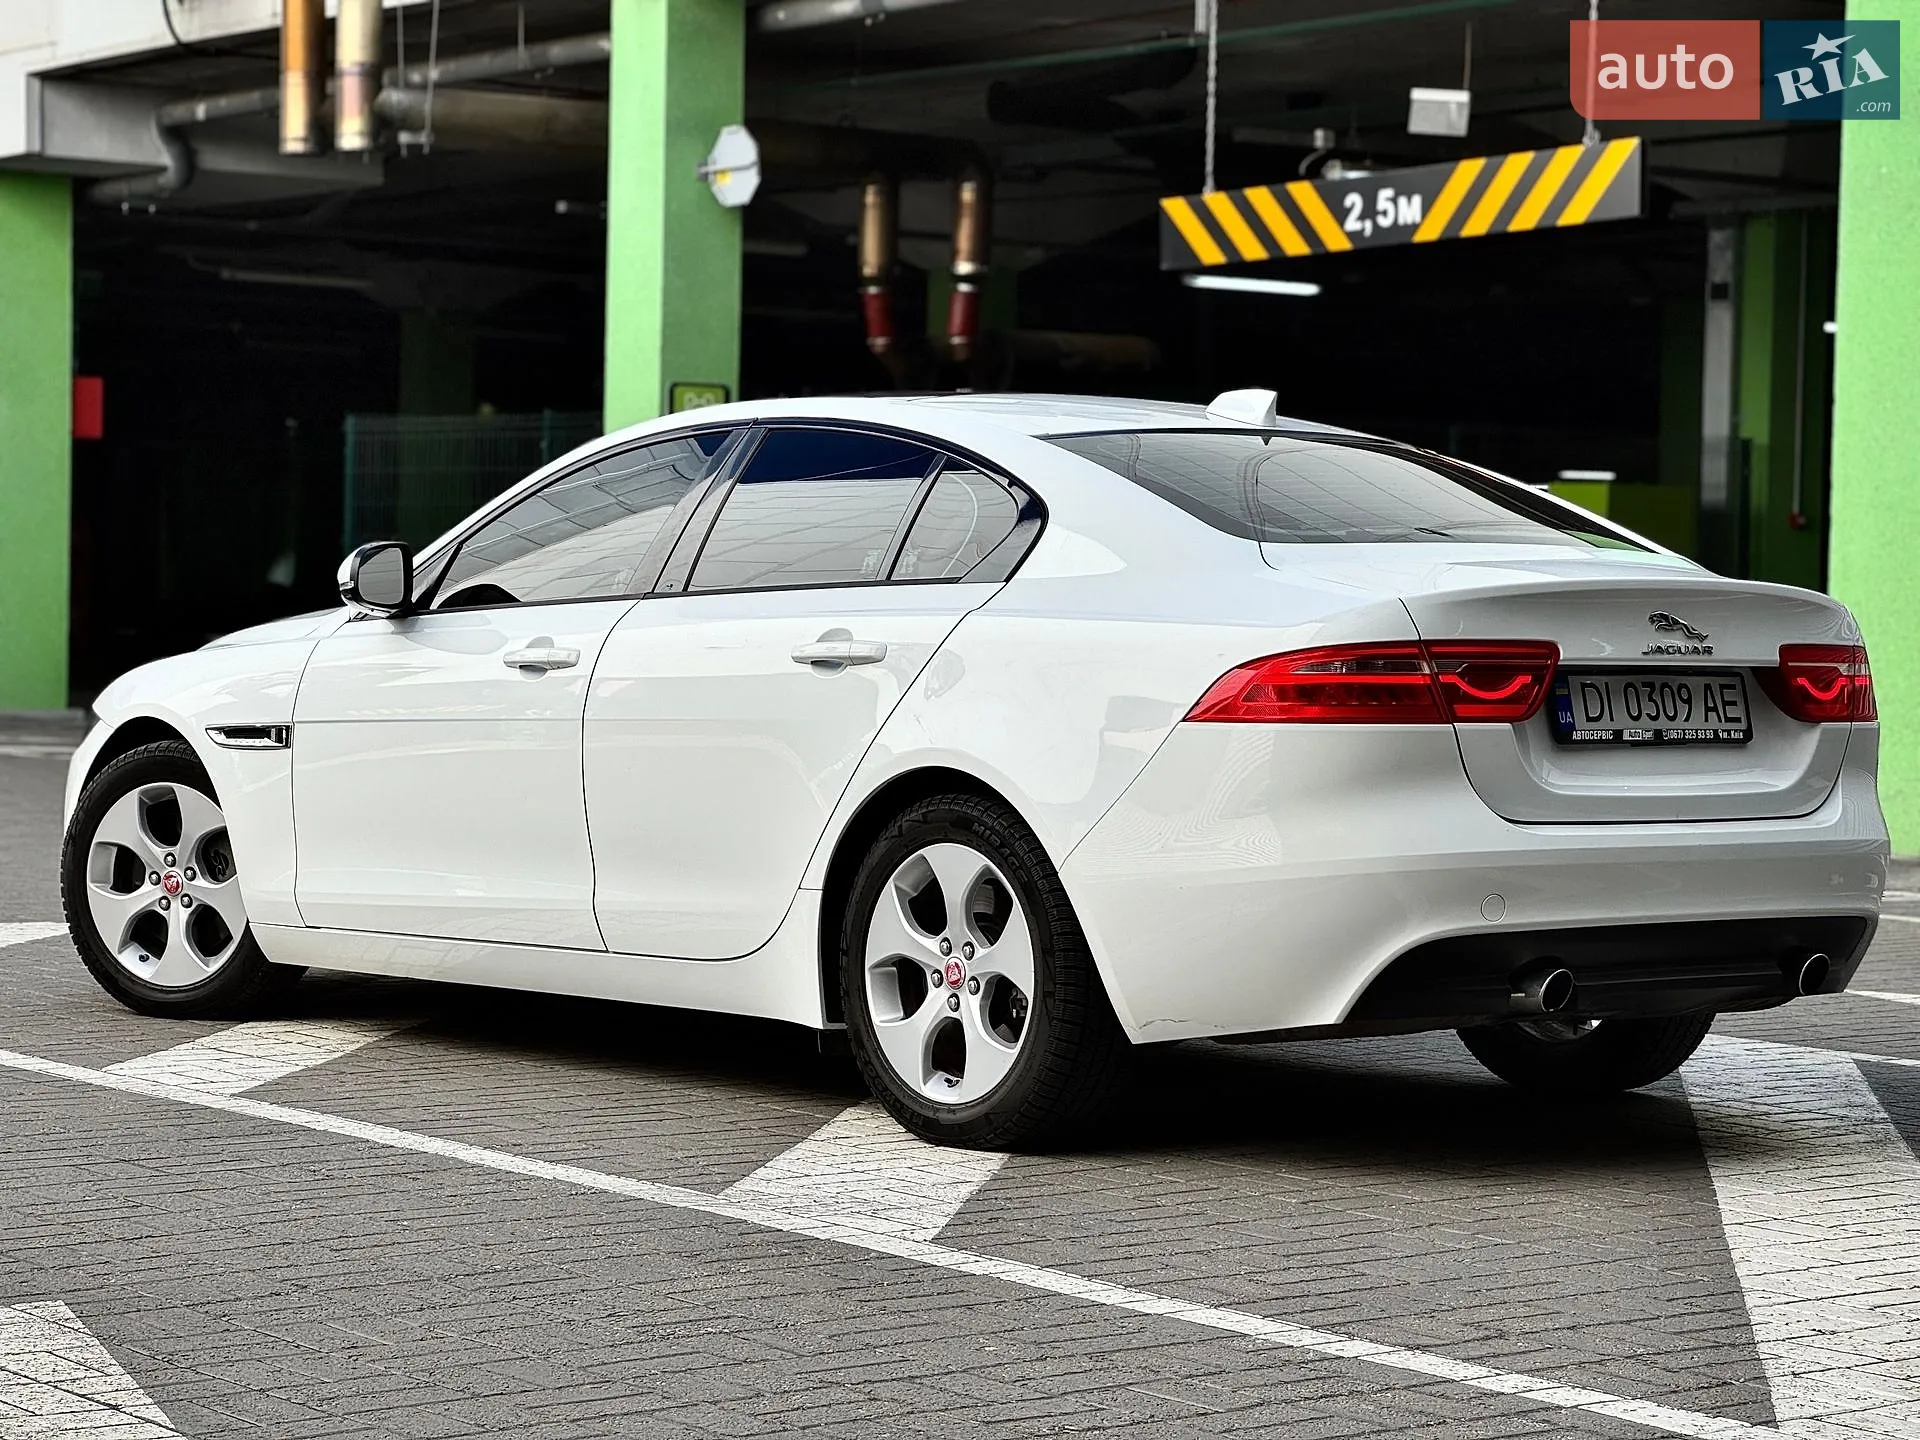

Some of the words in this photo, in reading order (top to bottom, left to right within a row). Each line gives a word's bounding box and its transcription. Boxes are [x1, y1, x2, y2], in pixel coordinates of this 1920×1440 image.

[1641, 643, 1714, 656] JAGUAR
[1580, 681, 1615, 722] DI
[1623, 681, 1693, 723] 0309
[1703, 682, 1743, 724] AE
[1558, 711, 1574, 724] UA
